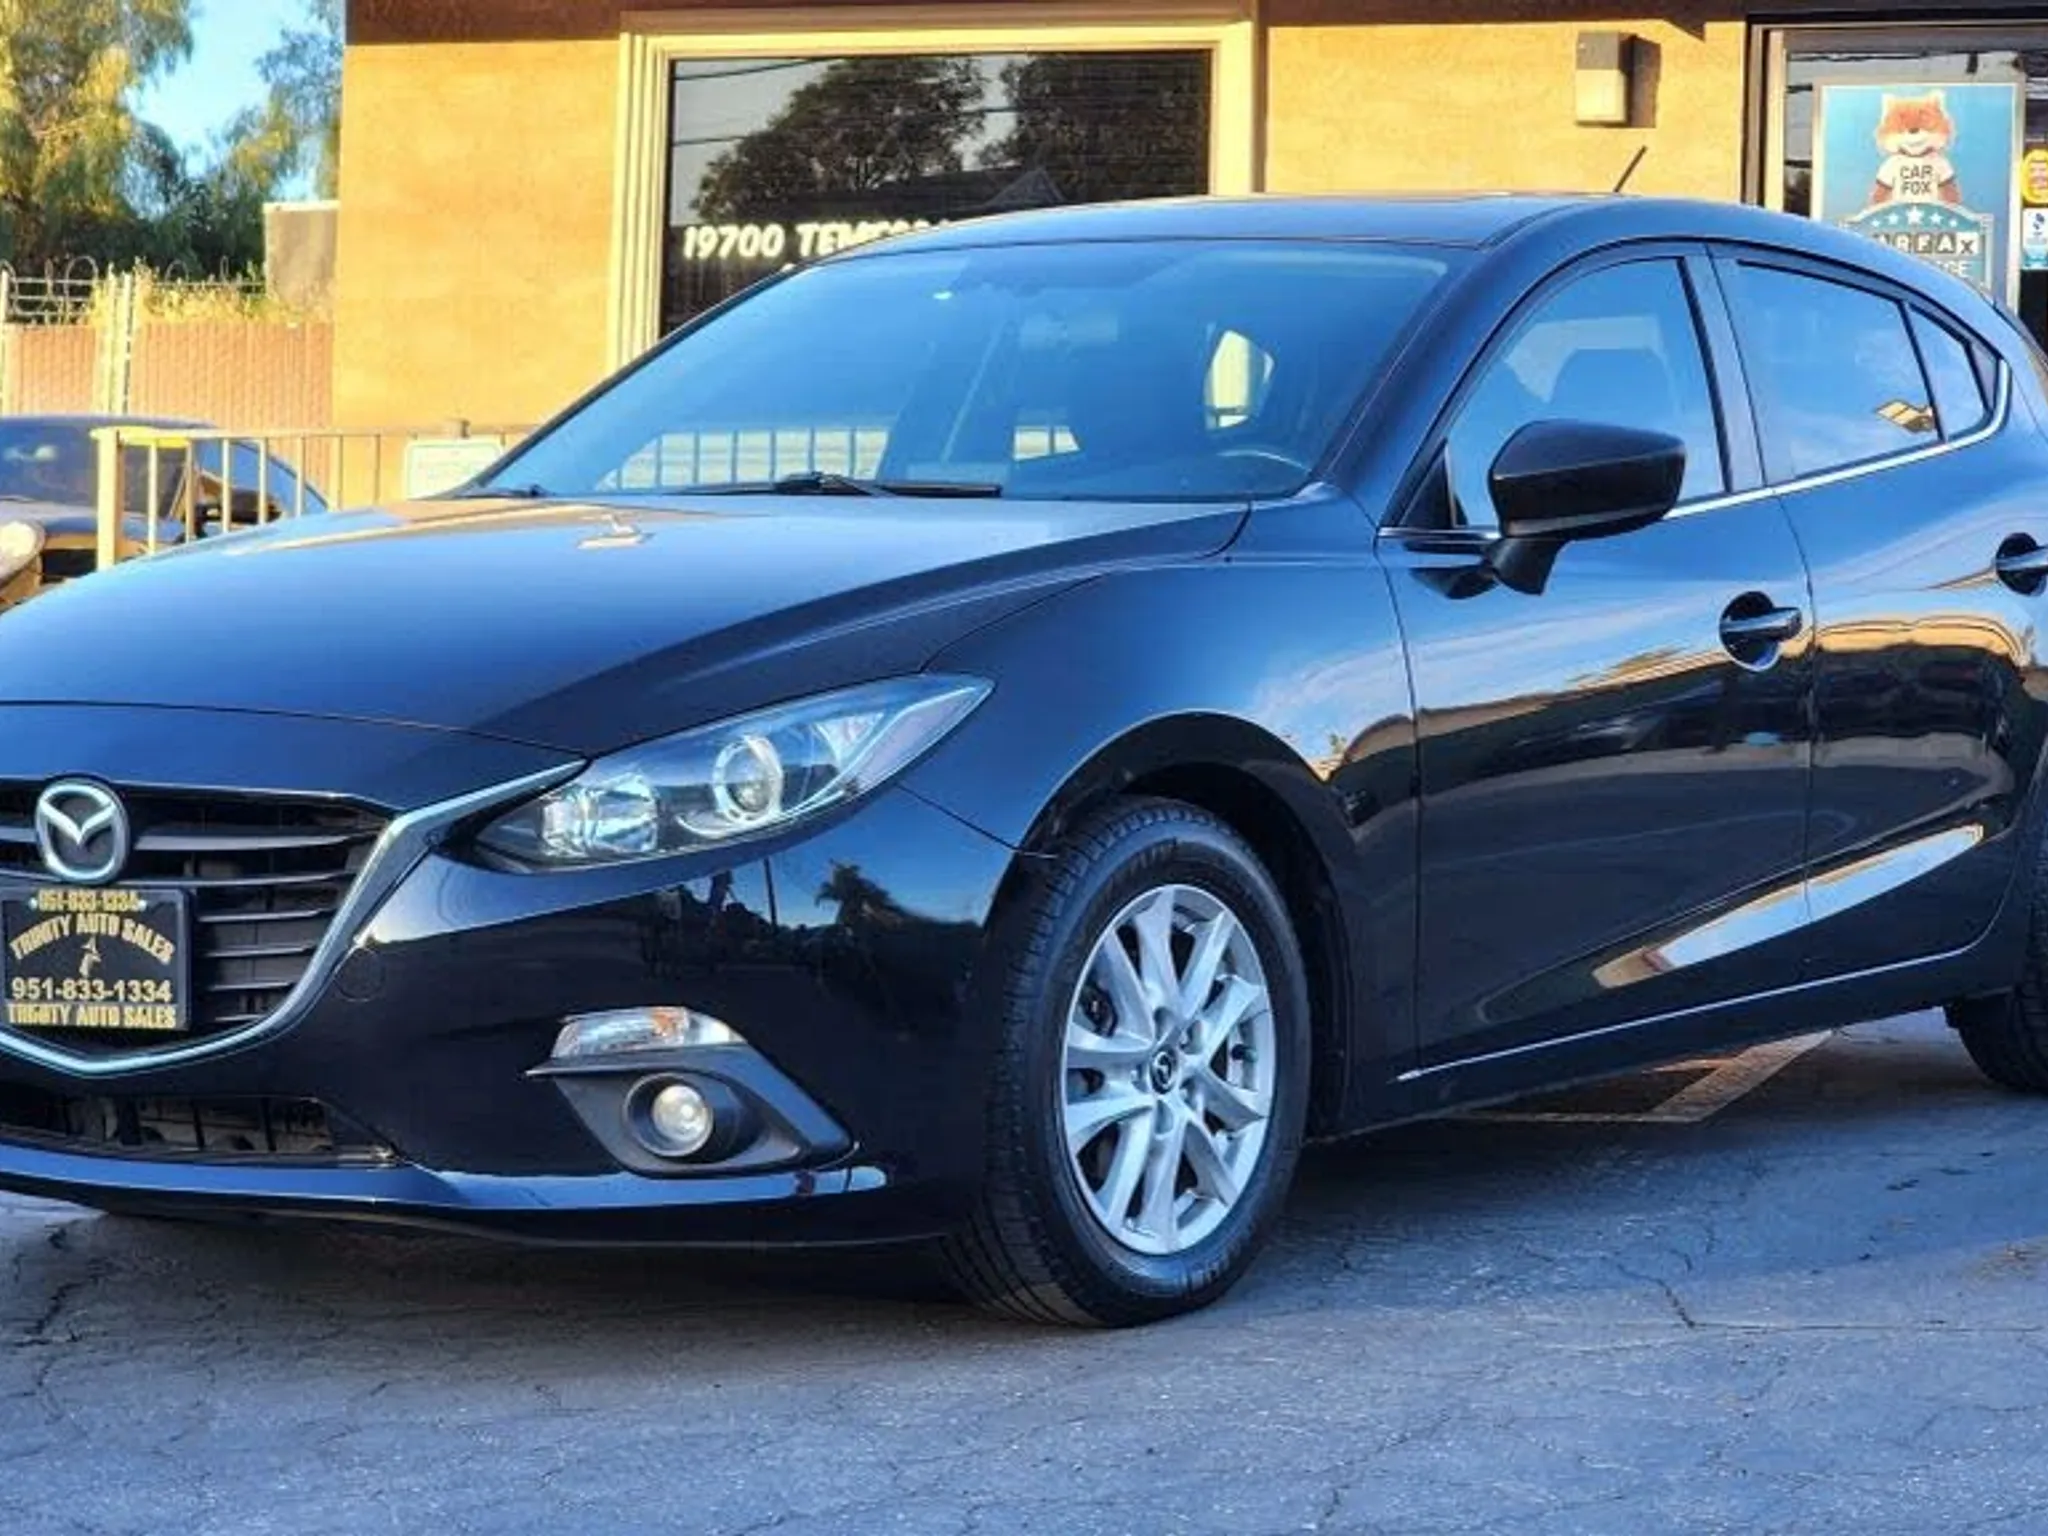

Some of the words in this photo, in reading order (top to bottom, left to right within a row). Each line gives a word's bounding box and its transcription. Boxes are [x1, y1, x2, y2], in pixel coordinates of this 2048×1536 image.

[1900, 165, 1933, 180] CAR
[1901, 181, 1932, 196] FOX
[683, 223, 786, 260] 19700
[9, 913, 72, 960] TRINITY
[76, 912, 121, 938] AUTO
[121, 918, 176, 966] SALES
[11, 976, 173, 1002] 951-833-1334
[76, 1004, 121, 1028] AUTO
[123, 1005, 177, 1030] SALES
